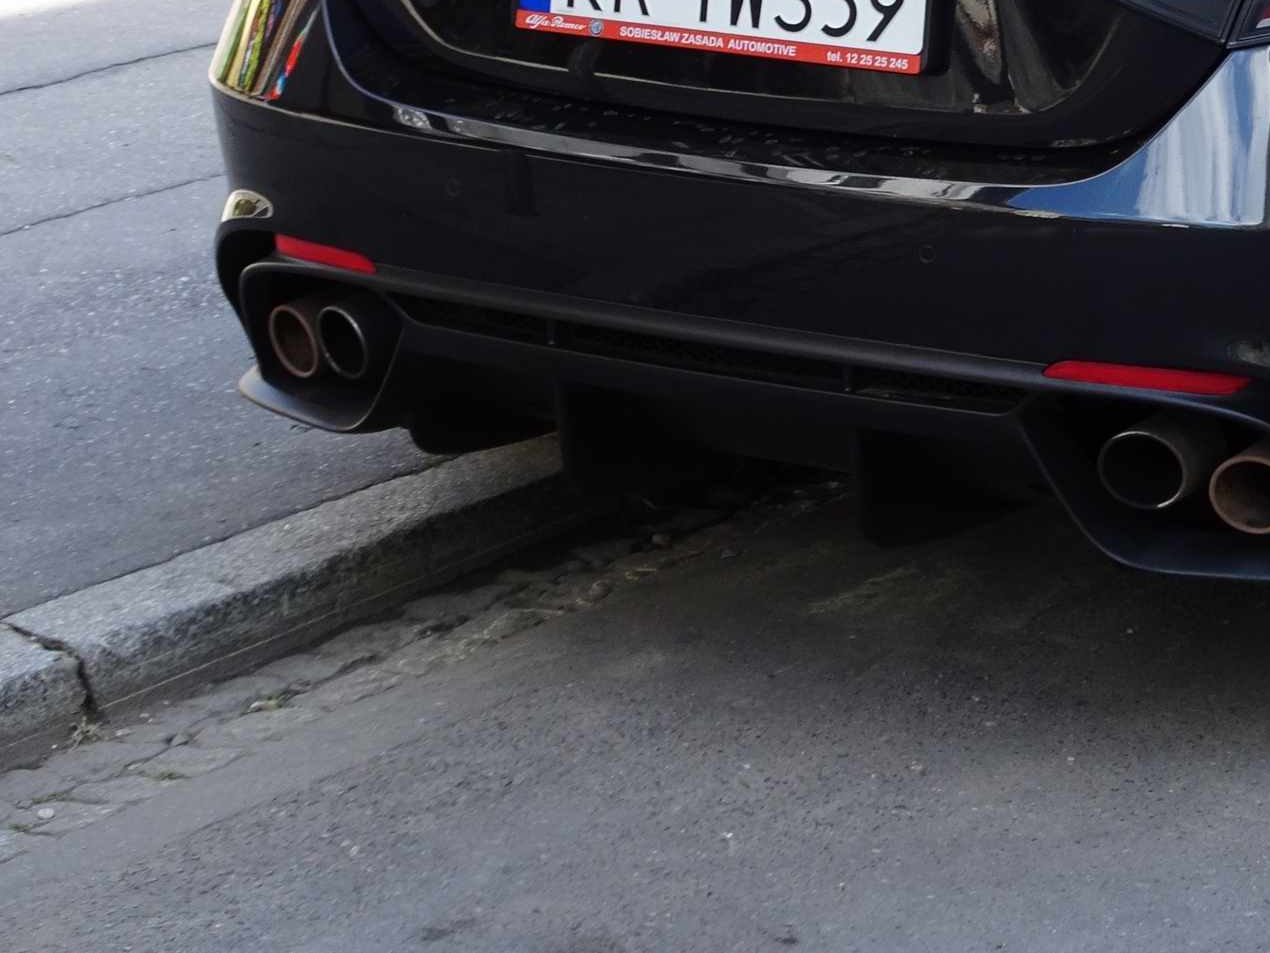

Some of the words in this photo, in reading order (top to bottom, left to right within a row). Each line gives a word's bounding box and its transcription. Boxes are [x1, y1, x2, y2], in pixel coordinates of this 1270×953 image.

[524, 14, 551, 30] Alfa
[550, 15, 588, 31] Romeo
[619, 26, 681, 43] SOBIESŁAW
[681, 33, 724, 49] ZASADA
[727, 39, 797, 57] AUTOMOTIVE
[826, 50, 843, 63] tel.
[845, 52, 859, 64] 12
[860, 54, 874, 66] 25
[874, 56, 888, 68] 25
[889, 57, 909, 70] 245
